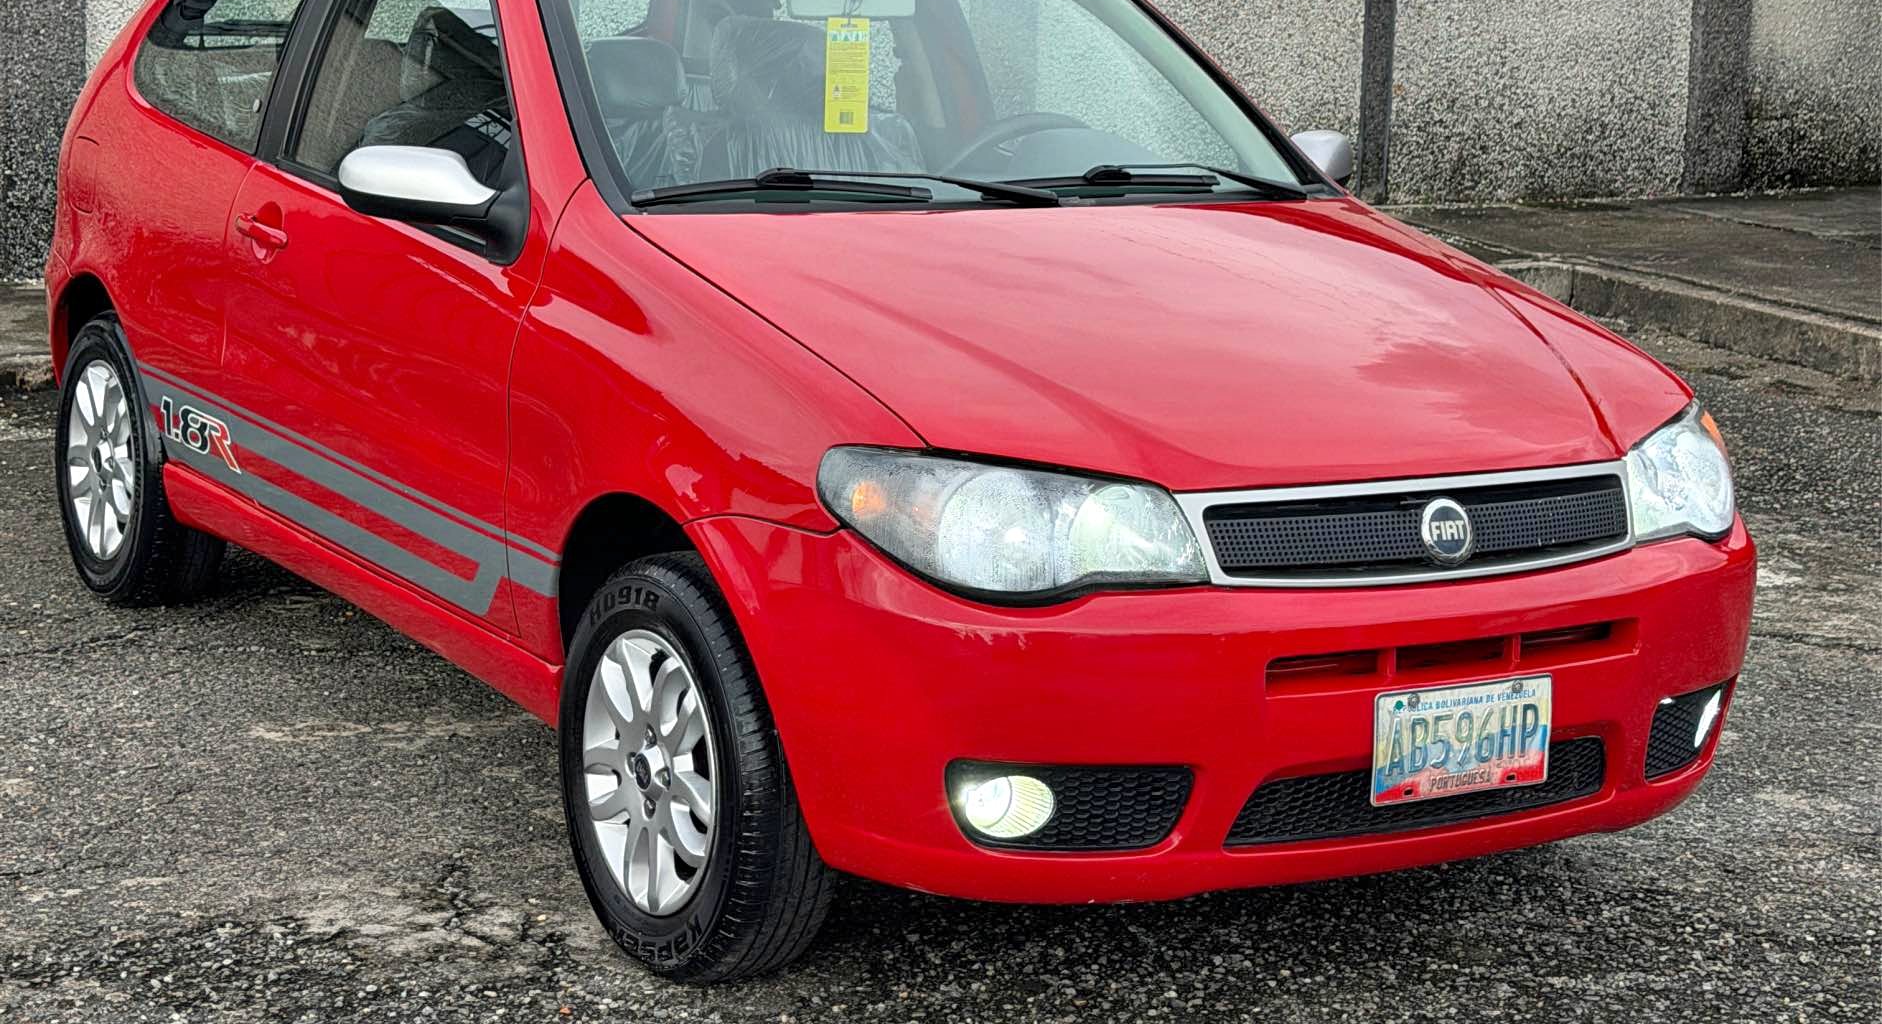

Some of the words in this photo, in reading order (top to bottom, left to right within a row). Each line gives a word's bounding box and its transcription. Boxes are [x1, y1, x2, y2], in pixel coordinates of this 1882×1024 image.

[1430, 520, 1465, 541] FIAT
[1435, 696, 1483, 709] BOLIVARIANA
[1486, 694, 1495, 703] DE
[1385, 703, 1540, 777] AB596HP
